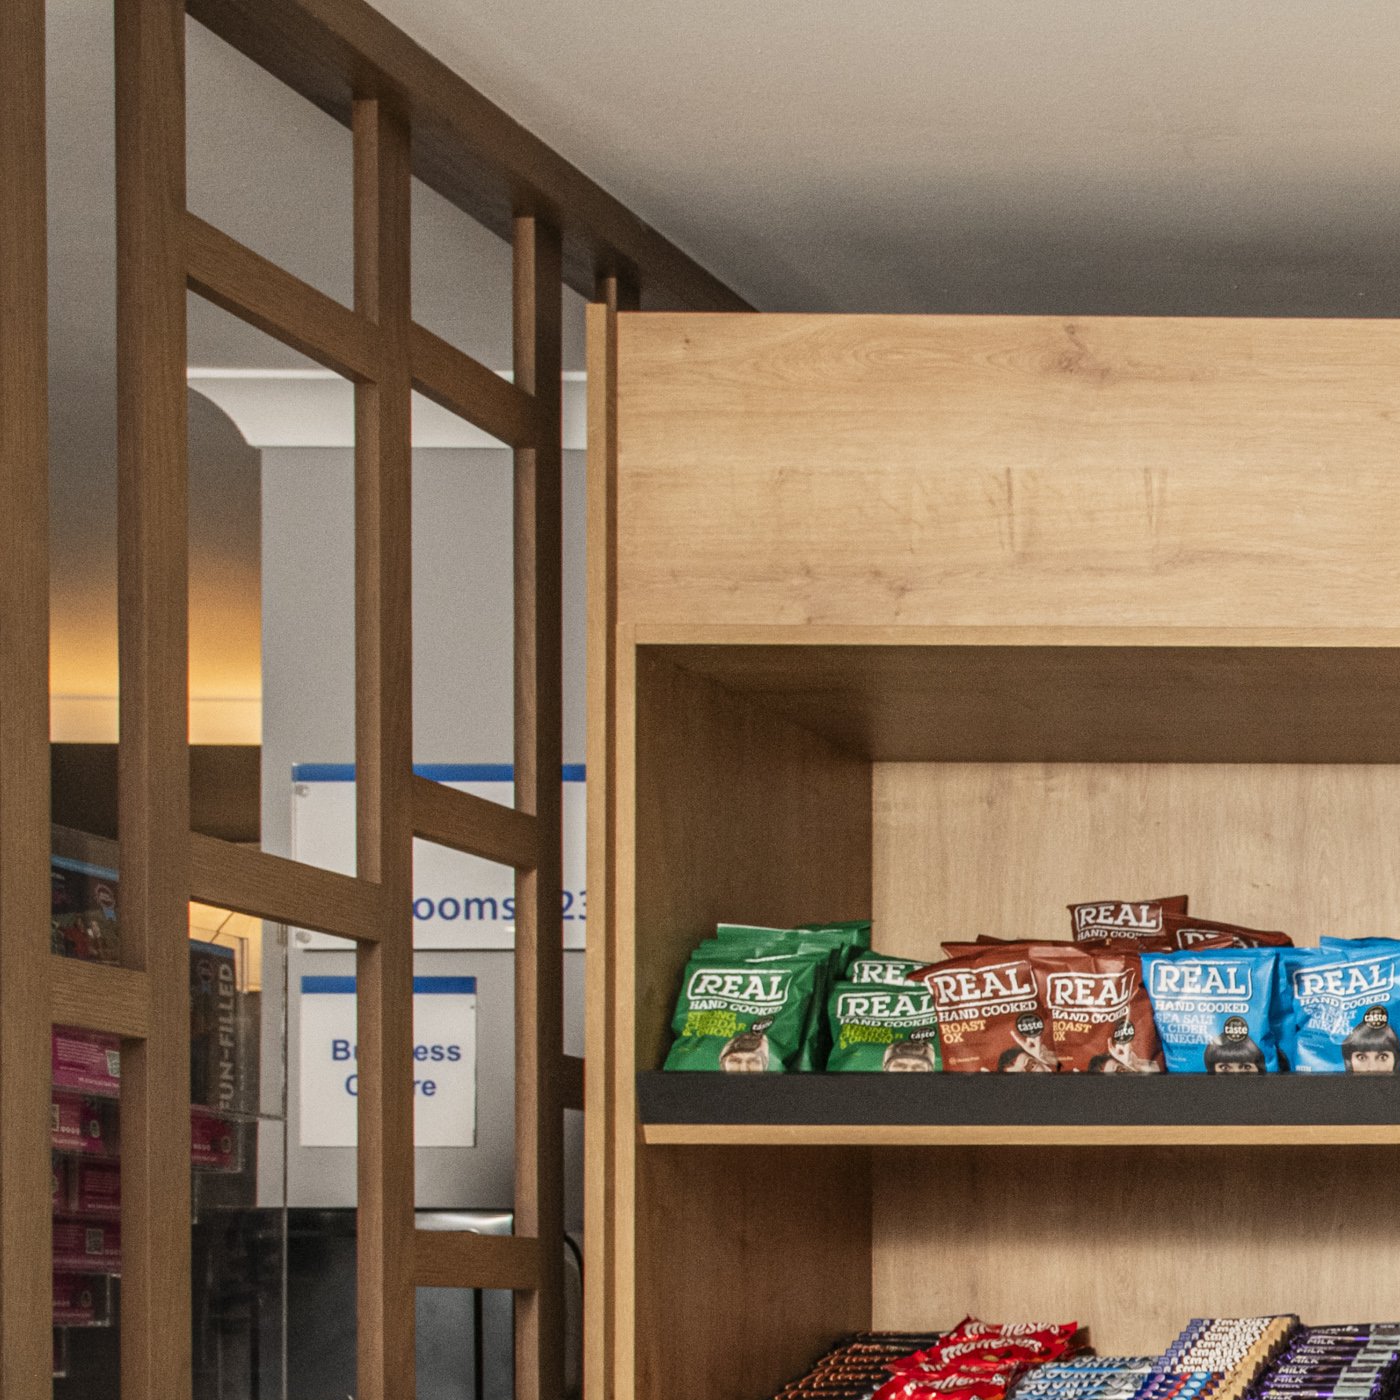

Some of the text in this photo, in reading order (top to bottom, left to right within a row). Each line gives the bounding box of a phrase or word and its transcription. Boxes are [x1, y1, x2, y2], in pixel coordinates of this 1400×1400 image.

[412, 897, 515, 921] ooms
[1079, 904, 1158, 928] REAL
[695, 974, 783, 1001] REAL
[934, 968, 1031, 1004] REAL
[1157, 966, 1246, 994] REAL
[1301, 963, 1387, 995] REAL
[1054, 976, 1129, 1005] REAL
[1301, 993, 1391, 1009] HAND COOKED
[689, 1000, 782, 1016] HAND COOKED
[848, 995, 934, 1018] REAL
[938, 1001, 1038, 1022] HAND COOKED
[1155, 1001, 1249, 1014] HAND COOKED
[941, 1020, 986, 1034] ROAST
[1053, 1021, 1092, 1034] ROAST
[1168, 1024, 1207, 1034] CIDER
[1183, 1014, 1215, 1023] SALT
[943, 1032, 964, 1044] OX
[331, 1039, 461, 1061] Bess
[1279, 1366, 1308, 1374] MILK
